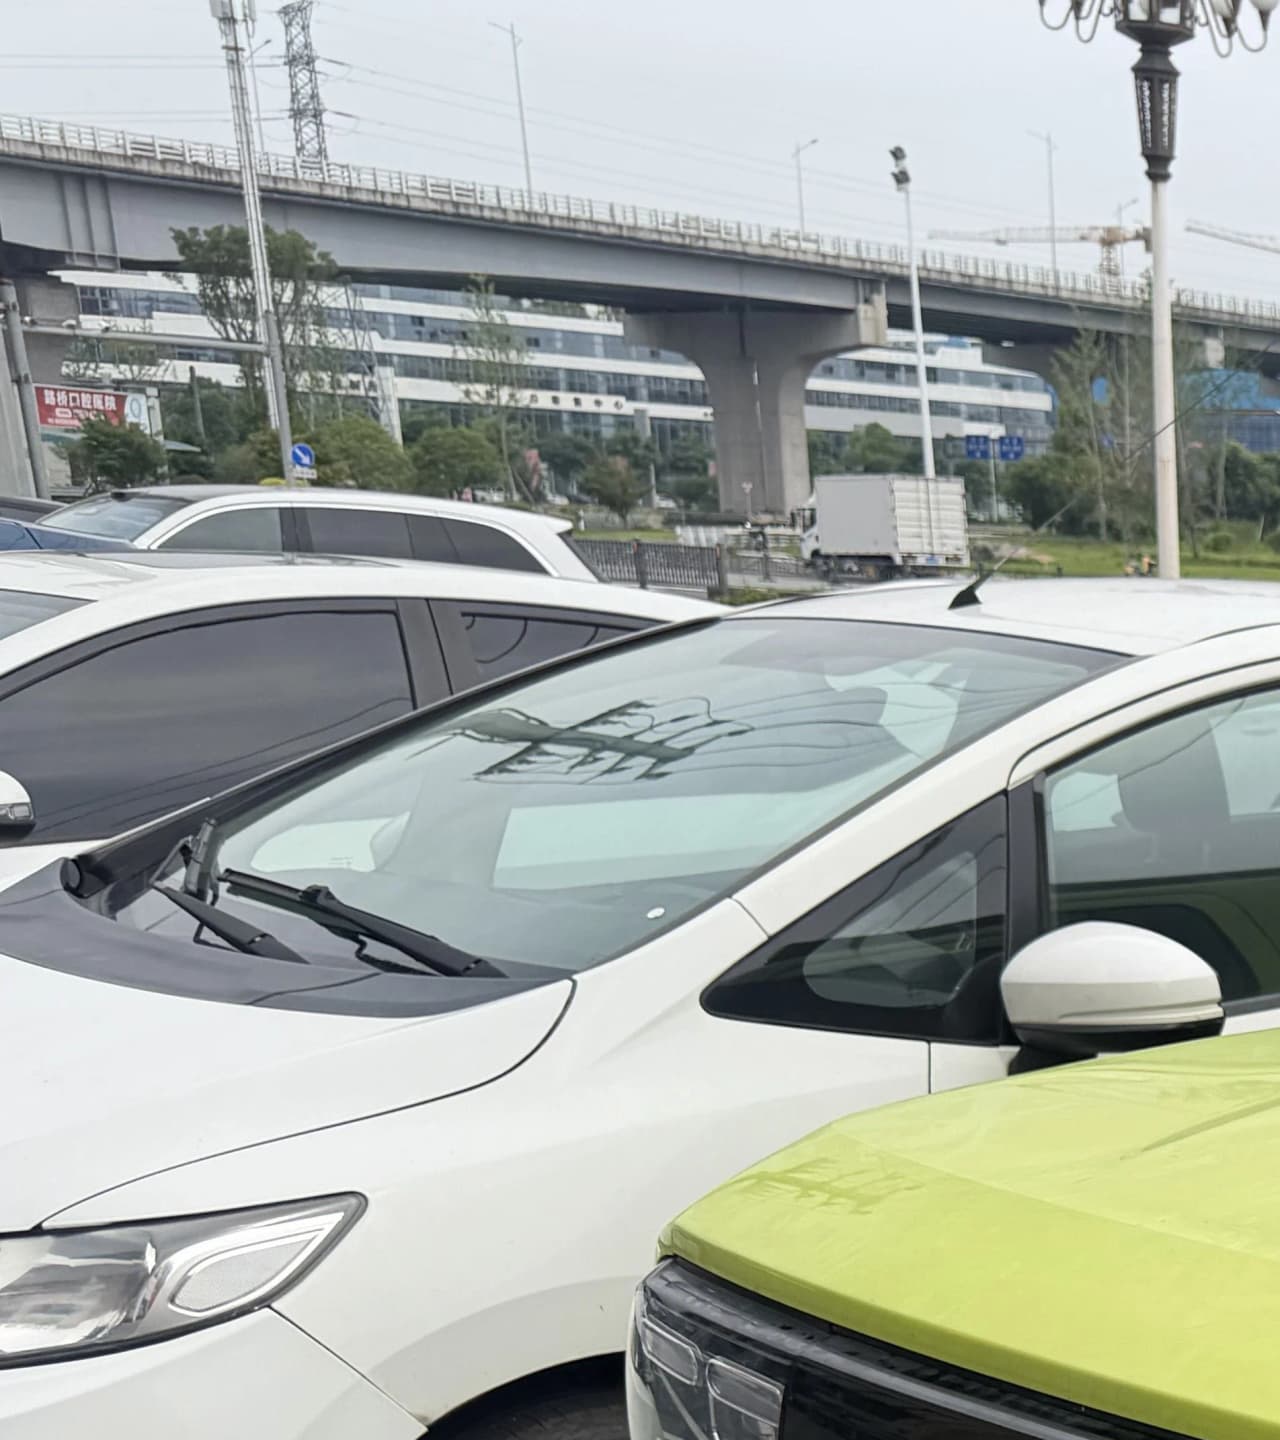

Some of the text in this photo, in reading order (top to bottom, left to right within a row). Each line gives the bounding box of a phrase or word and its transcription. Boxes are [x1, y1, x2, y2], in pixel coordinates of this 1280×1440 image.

[43, 389, 118, 411] 路桥口腔医院
